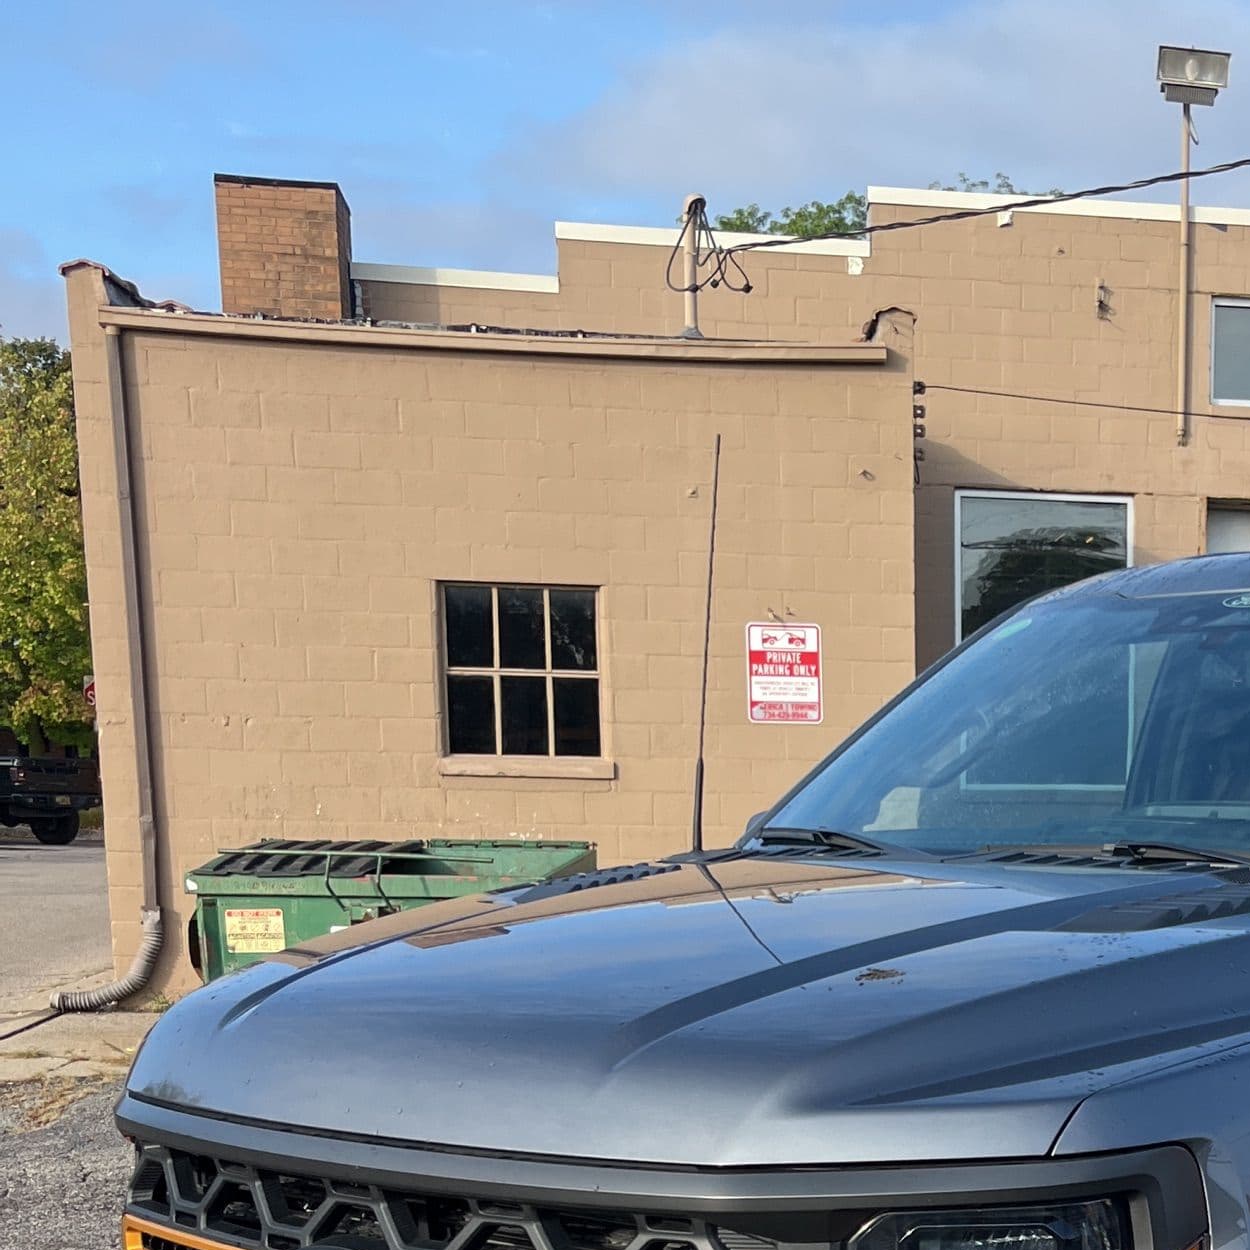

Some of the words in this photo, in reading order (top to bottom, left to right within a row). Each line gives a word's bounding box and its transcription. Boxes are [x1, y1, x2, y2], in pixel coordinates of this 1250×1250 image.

[766, 652, 802, 663] PRIVATE
[752, 664, 791, 675] PARKING
[793, 665, 817, 676] ONLY
